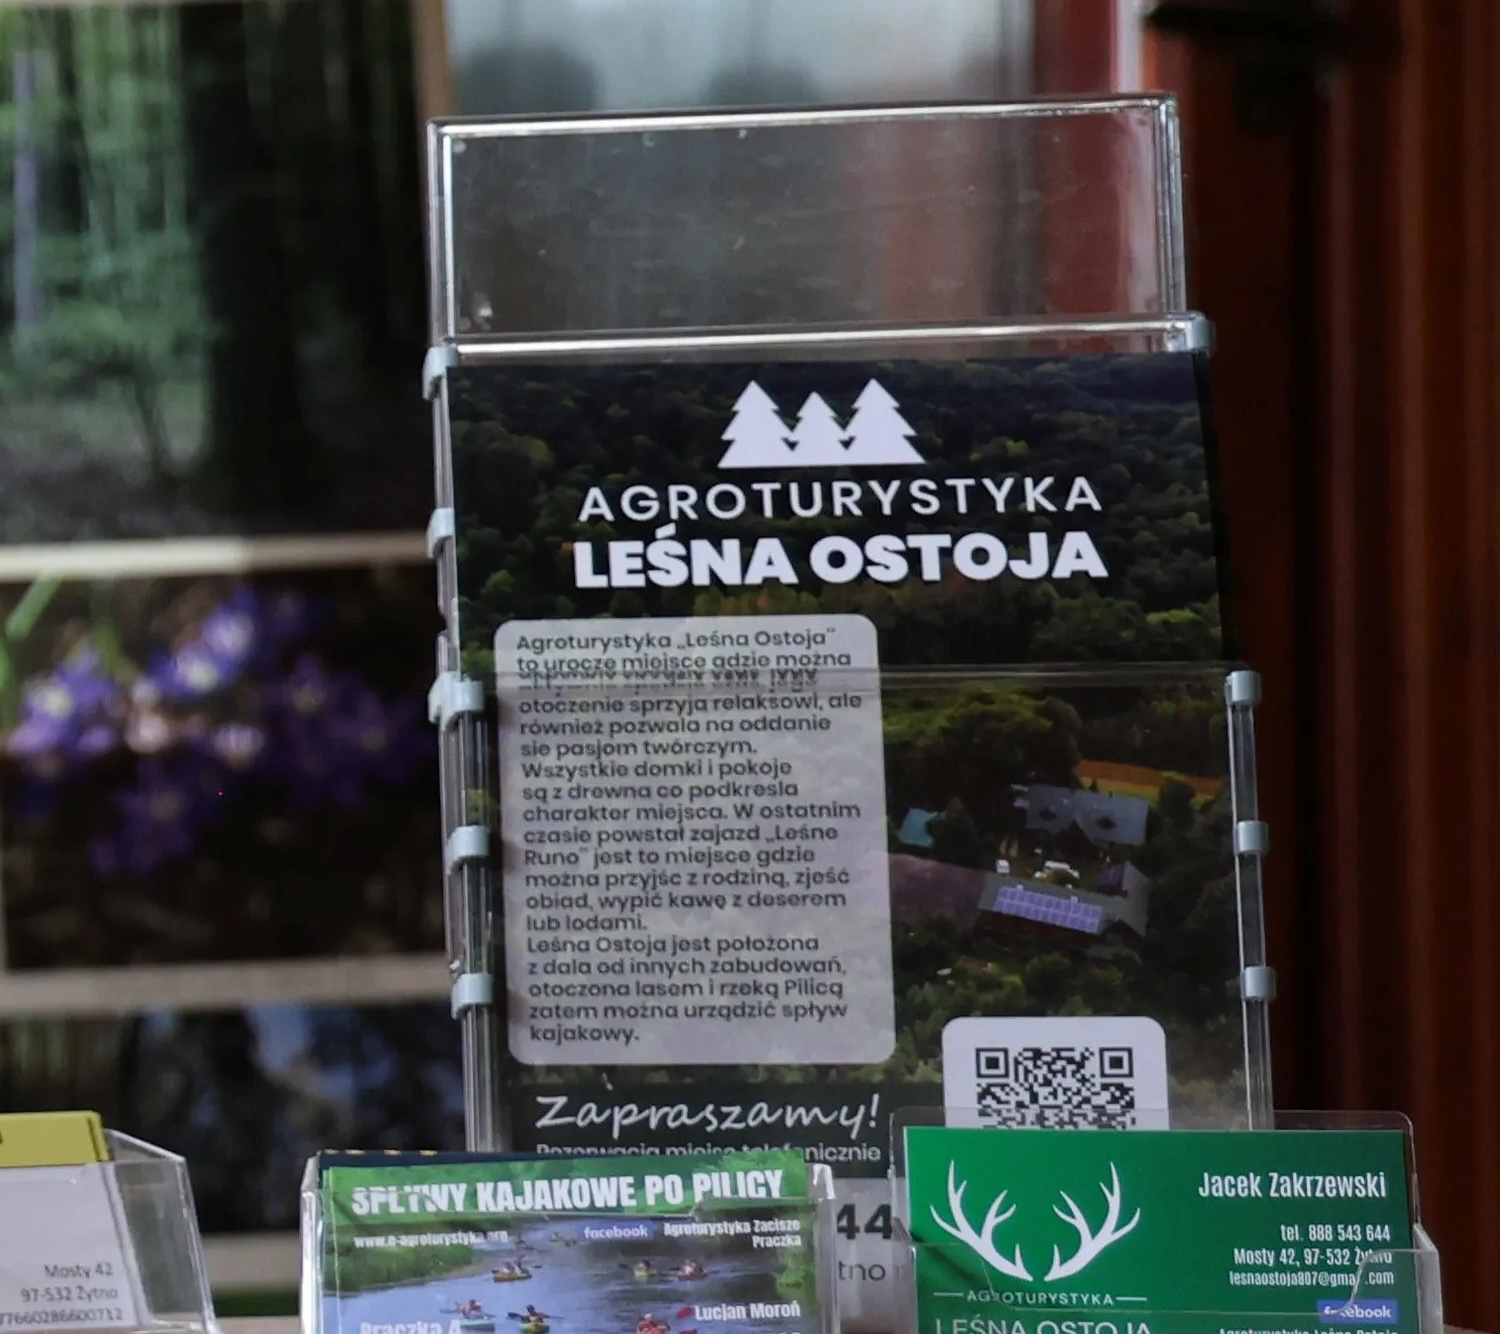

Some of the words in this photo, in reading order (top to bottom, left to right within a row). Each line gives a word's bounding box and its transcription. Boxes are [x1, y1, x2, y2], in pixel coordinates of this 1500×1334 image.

[578, 475, 1102, 523] AGROTURYSTYKA
[572, 523, 799, 590] LEŚNA
[809, 531, 1108, 586] OSTOJA
[517, 634, 671, 654] Agroturystyka
[517, 657, 537, 672] to
[543, 657, 615, 672] urocze
[622, 653, 706, 672] miejsce
[776, 652, 851, 667] można
[520, 697, 623, 713] otoczenie
[630, 697, 707, 718] sprzyja
[714, 691, 823, 711] relaksowi,
[829, 694, 861, 708] ale
[520, 717, 604, 736] również
[610, 717, 700, 740] pozwala
[706, 718, 733, 732] na
[740, 716, 831, 731] oddanie
[557, 739, 637, 762] pasjom
[644, 738, 757, 759] twórczym.
[522, 761, 629, 782] Wszystkie
[635, 759, 701, 776] domki
[719, 758, 792, 781] pokoje
[523, 785, 547, 804] są
[568, 782, 651, 799] drewna
[656, 784, 682, 798] co
[523, 804, 628, 822] charakter
[636, 803, 728, 824] miejsca.
[733, 804, 754, 819] W
[760, 802, 860, 819] ostatnim
[524, 826, 591, 843] czasie
[597, 823, 684, 848] powstał
[690, 825, 759, 845] zajazd
[593, 848, 632, 868] jest
[638, 850, 659, 864] to
[664, 848, 752, 867] miejsce
[757, 846, 815, 867] gdzie
[525, 868, 599, 887] można
[703, 869, 790, 890] rodziną,
[794, 868, 850, 890] zjeść
[526, 893, 592, 911] obiad,
[597, 893, 662, 914] wypić
[668, 892, 727, 912] kawę
[748, 891, 846, 908] deserem
[526, 914, 561, 931] lub
[566, 914, 647, 931] lodami.
[527, 935, 590, 954] Leśna
[596, 934, 666, 958] Ostoja
[671, 934, 711, 956] jest
[543, 957, 591, 975] dala
[597, 957, 624, 974] od
[630, 956, 705, 979] innych
[710, 955, 847, 977] zabudowań,
[529, 981, 630, 998] otoczona
[635, 979, 703, 997] lasem
[719, 979, 779, 1000] rzeką
[785, 978, 843, 999] Pilicą
[530, 1005, 597, 1020] zatem
[604, 1002, 677, 1020] można
[684, 1001, 775, 1022] urządzić
[782, 1001, 847, 1022] spływ
[530, 1024, 639, 1046] kajakowy.
[536, 1092, 879, 1140] Zapraszamy!
[476, 1176, 637, 1212] KAJAKOWE
[646, 1174, 683, 1205] PO
[693, 1169, 784, 1203] PILICY
[1199, 1172, 1262, 1197] Jacek
[1269, 1172, 1386, 1197] Zakrzewski
[584, 1224, 647, 1239] facebook
[752, 1234, 802, 1248] Praczka
[1281, 1224, 1303, 1241] tel.
[1309, 1225, 1332, 1241] 888
[1337, 1225, 1361, 1241] 543
[1366, 1224, 1391, 1241] 644
[1234, 1248, 1275, 1267] Mosty
[1280, 1248, 1300, 1267] 42,
[1304, 1248, 1350, 1265] 97-532
[694, 1301, 744, 1322] Lucjan
[750, 1299, 800, 1318] Moroń
